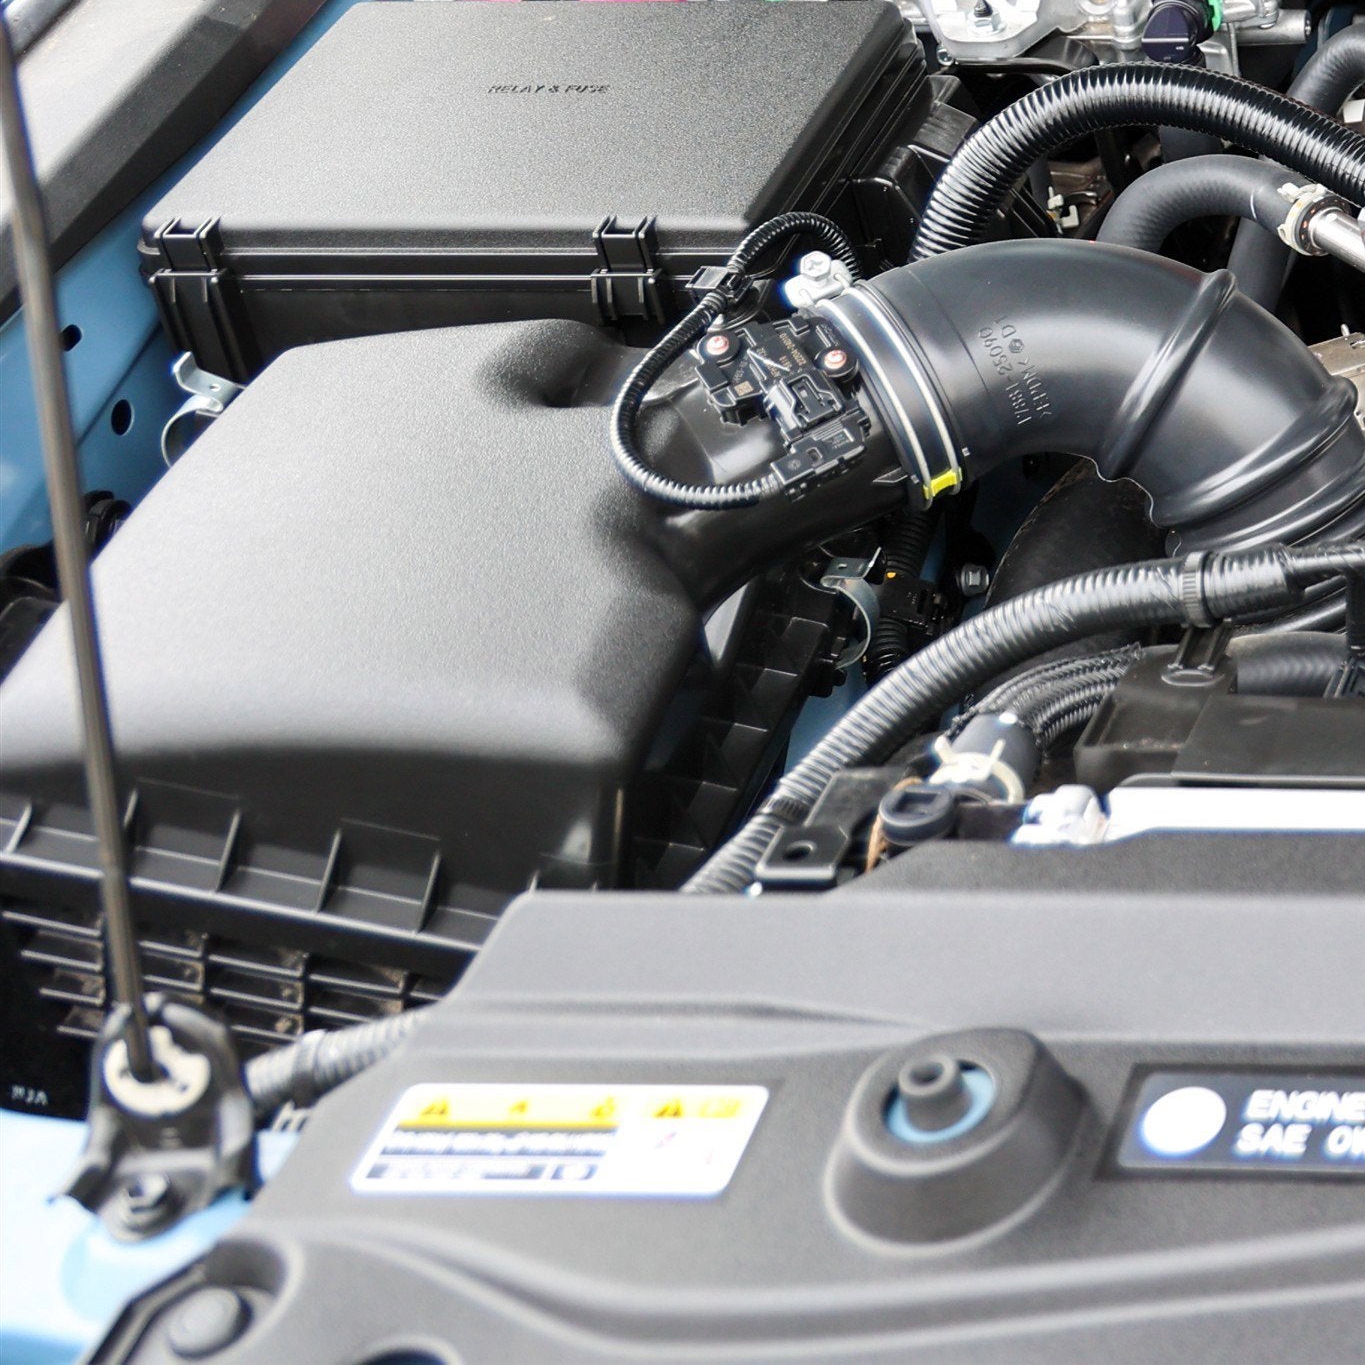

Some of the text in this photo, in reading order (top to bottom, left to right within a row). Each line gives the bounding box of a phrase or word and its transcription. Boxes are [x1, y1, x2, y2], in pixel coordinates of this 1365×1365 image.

[487, 84, 610, 94] RELAY & FUSE
[1235, 1122, 1312, 1155] SAE
